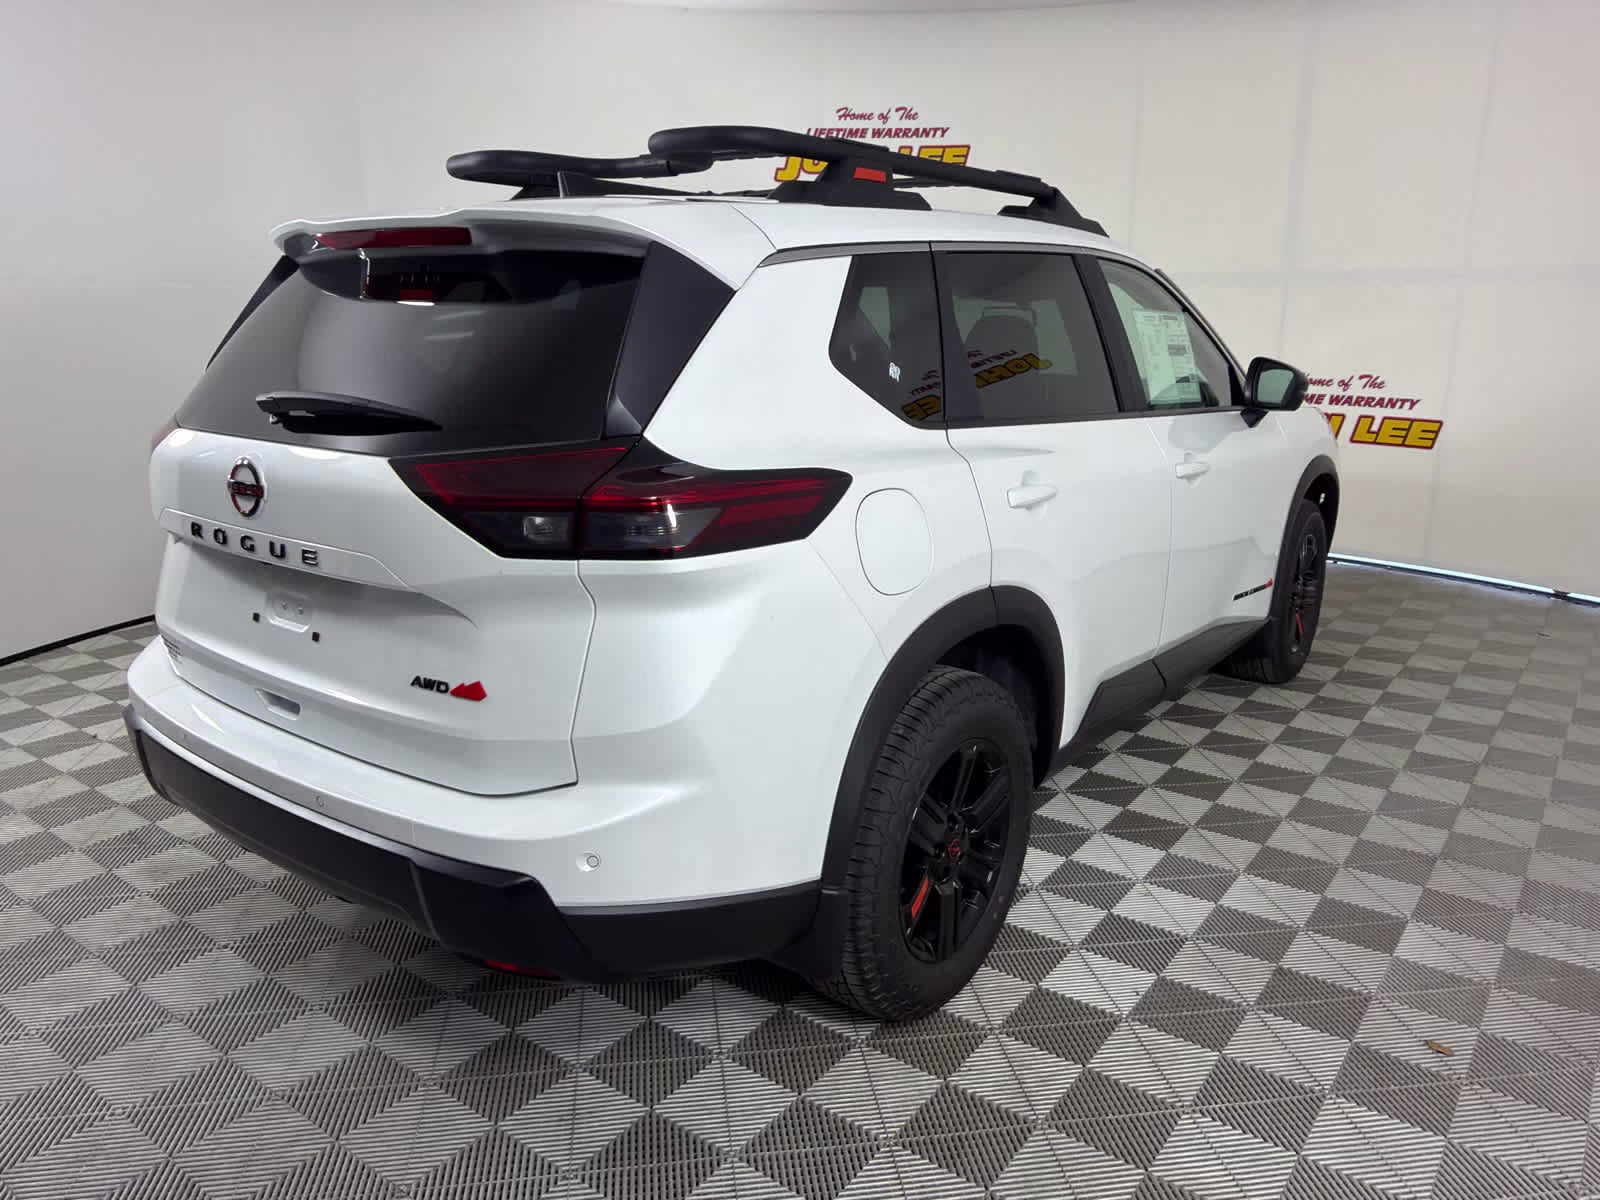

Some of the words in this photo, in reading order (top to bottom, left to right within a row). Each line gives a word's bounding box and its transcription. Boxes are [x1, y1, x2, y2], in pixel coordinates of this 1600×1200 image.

[835, 106, 875, 121] Home
[877, 107, 892, 125] of
[895, 105, 920, 121] The
[871, 127, 951, 139] WARRANTY
[1308, 377, 1334, 388] ome
[1337, 375, 1354, 392] of
[1358, 374, 1386, 390] The
[1328, 393, 1422, 411] WARRANTY
[1349, 415, 1444, 450] LEE
[190, 521, 319, 566] ROGUE
[410, 675, 450, 694] AWD
